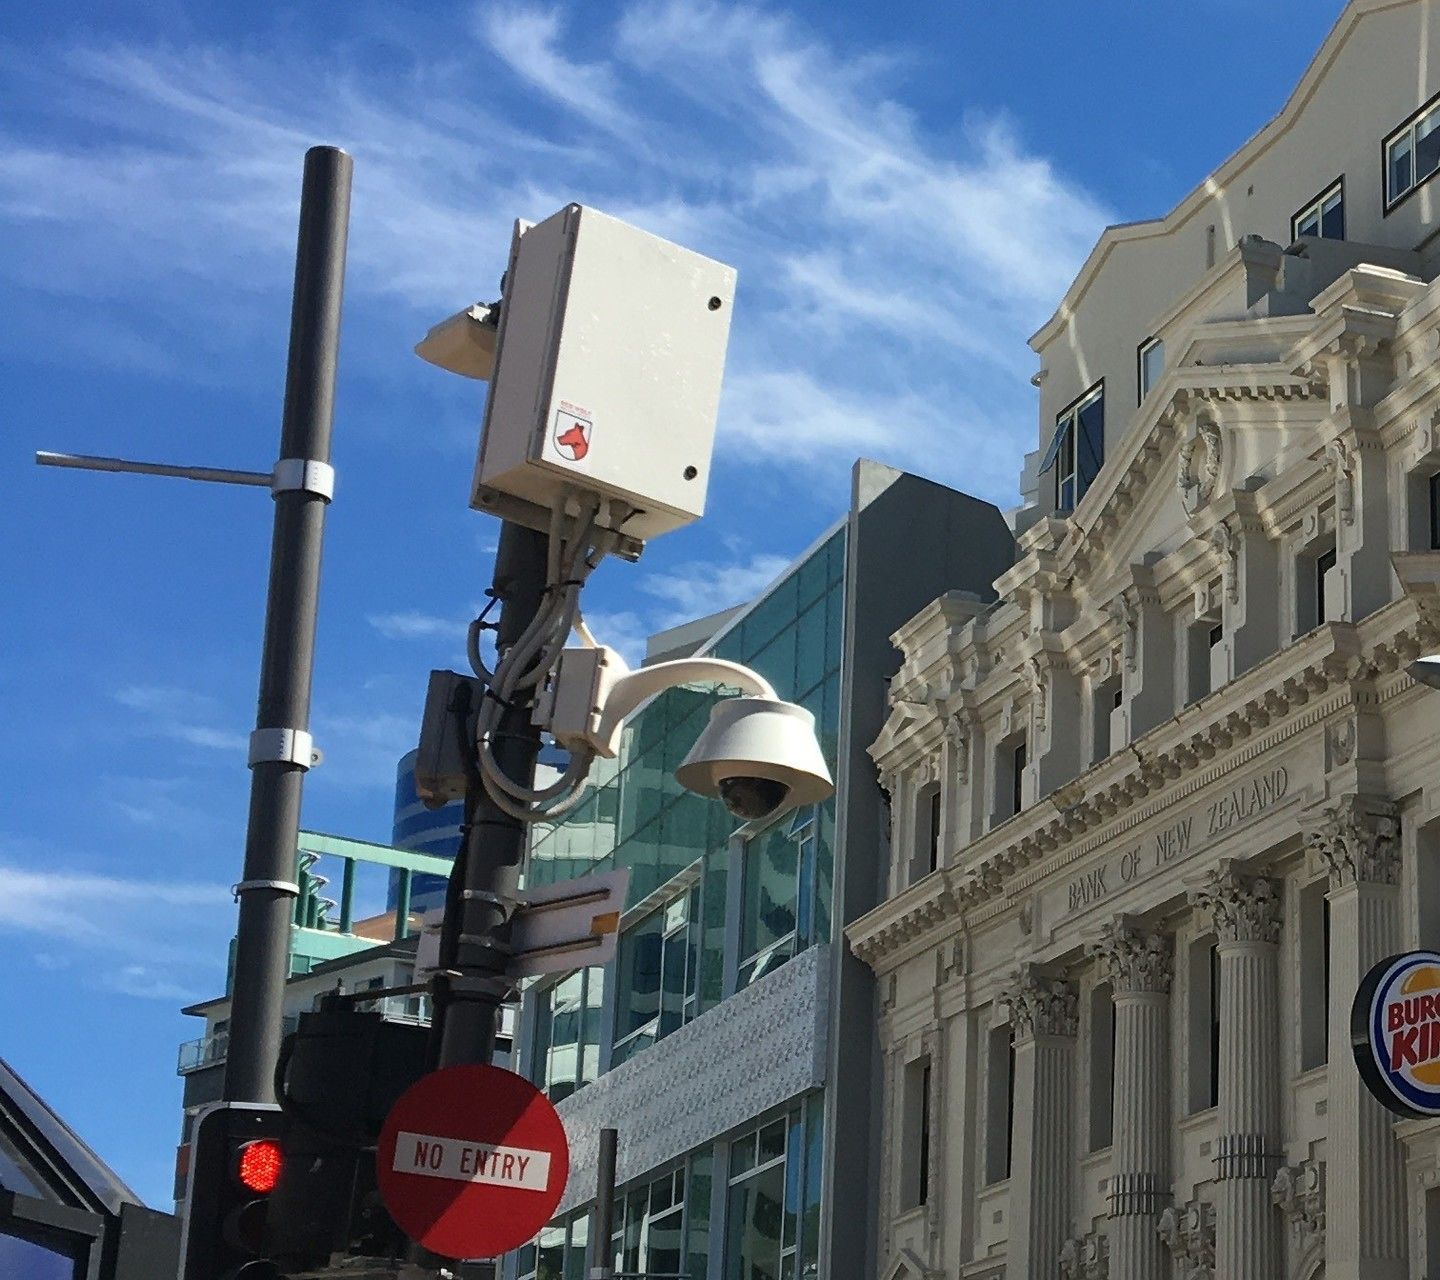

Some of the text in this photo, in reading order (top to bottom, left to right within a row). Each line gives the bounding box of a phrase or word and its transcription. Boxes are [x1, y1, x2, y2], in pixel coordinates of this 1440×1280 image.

[1068, 766, 1288, 911] BANK OF NEW ZEALAND
[414, 1141, 531, 1181] NO ENTRY
